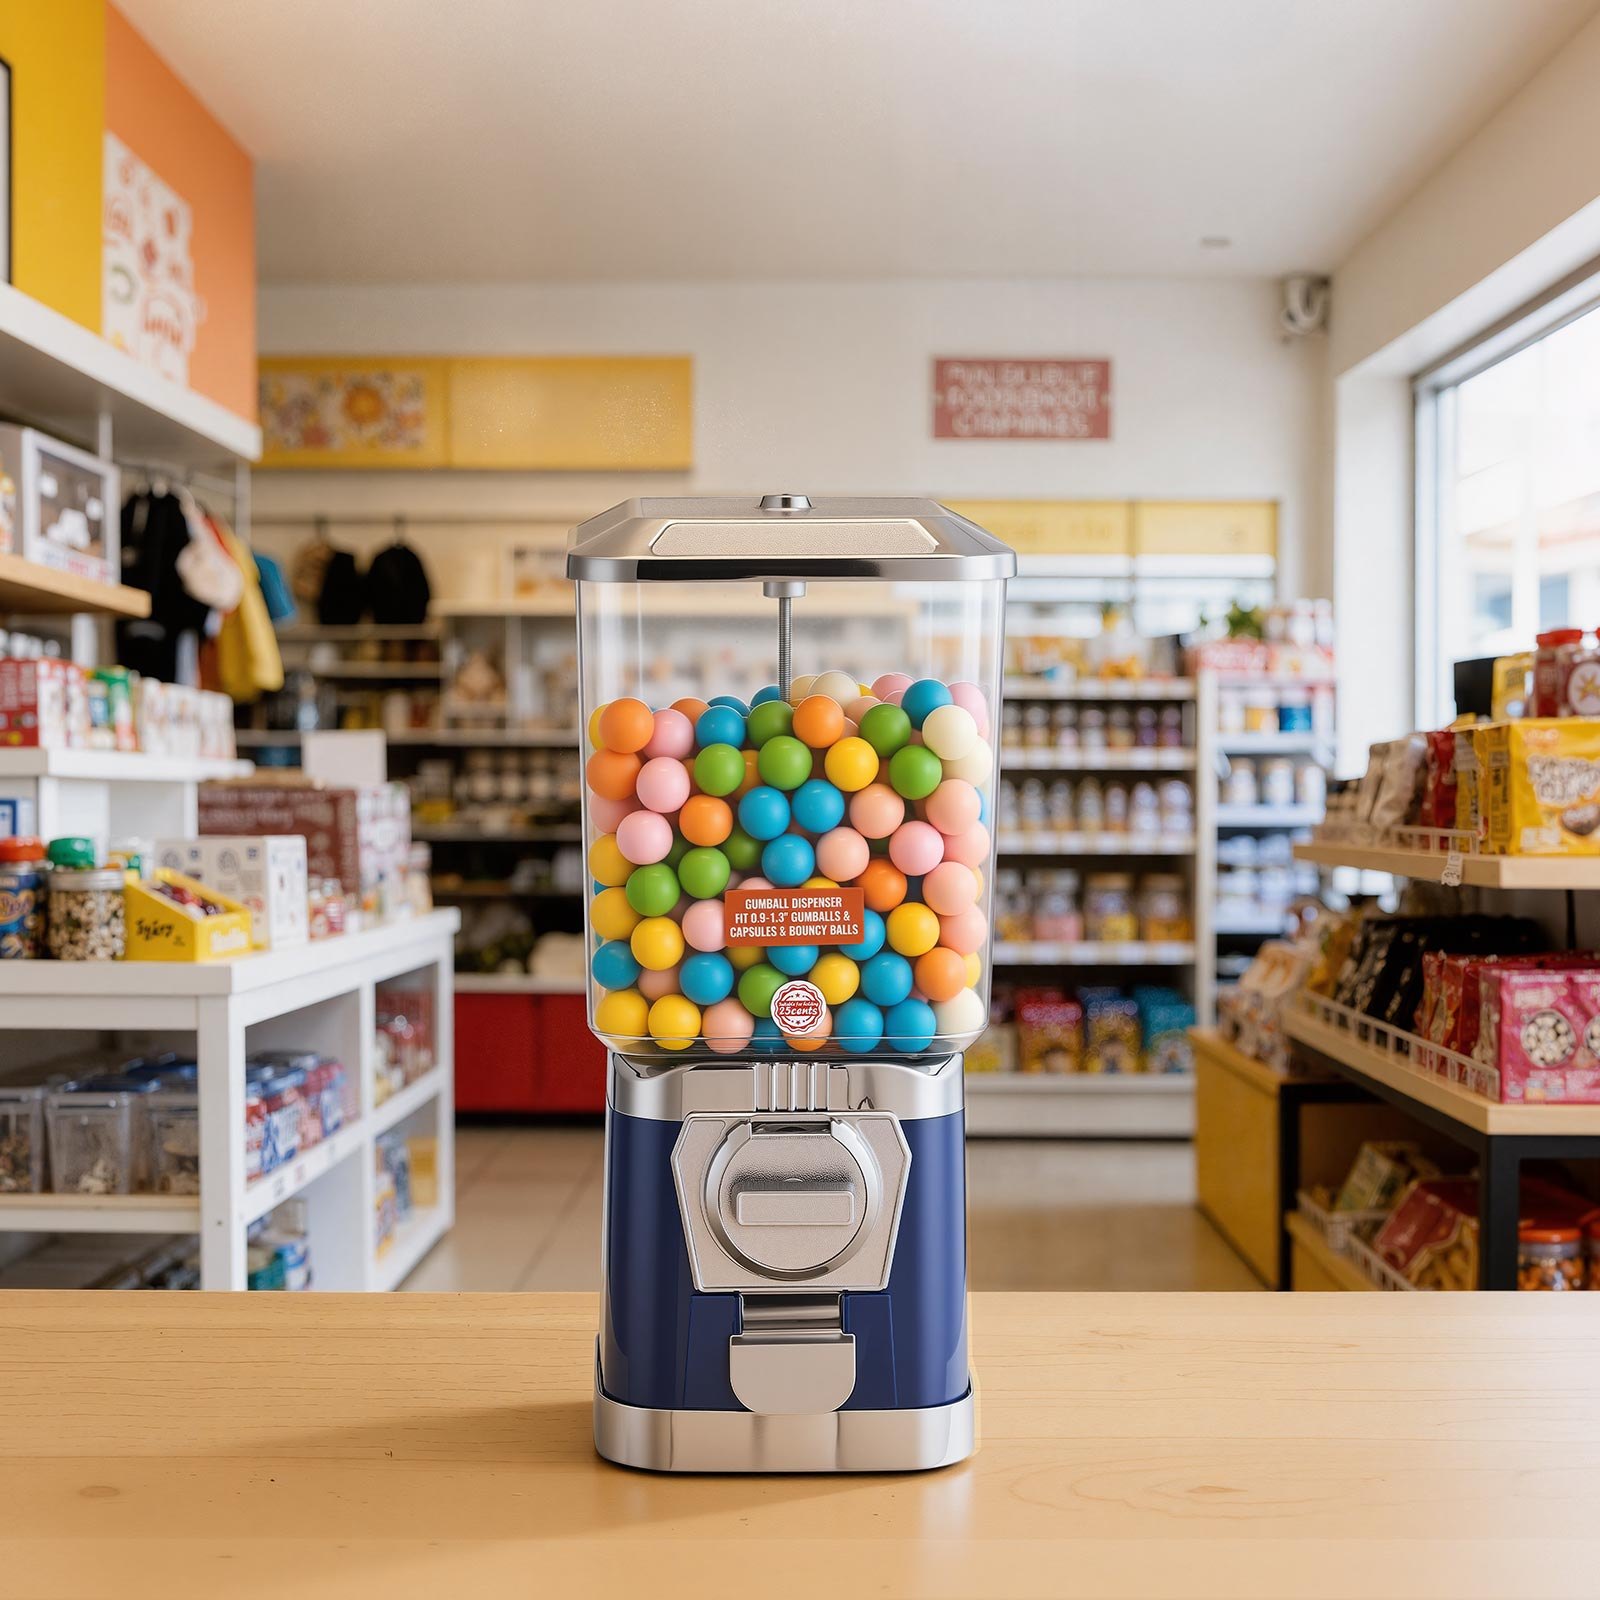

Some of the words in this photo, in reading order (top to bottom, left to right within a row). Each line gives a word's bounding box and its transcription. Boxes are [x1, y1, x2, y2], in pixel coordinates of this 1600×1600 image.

[745, 898, 789, 910] GUMBALL
[792, 896, 842, 909] DISPENSER
[735, 913, 748, 924] FIT
[750, 912, 788, 924] 0.9-1.3"
[791, 911, 841, 922] GUMBALLS
[843, 910, 851, 921] &
[730, 926, 777, 938] CAPSULES
[779, 926, 787, 937] &
[789, 925, 827, 936] BOUNCY
[830, 924, 859, 935] BALLS
[779, 1006, 818, 1015] 25cents
